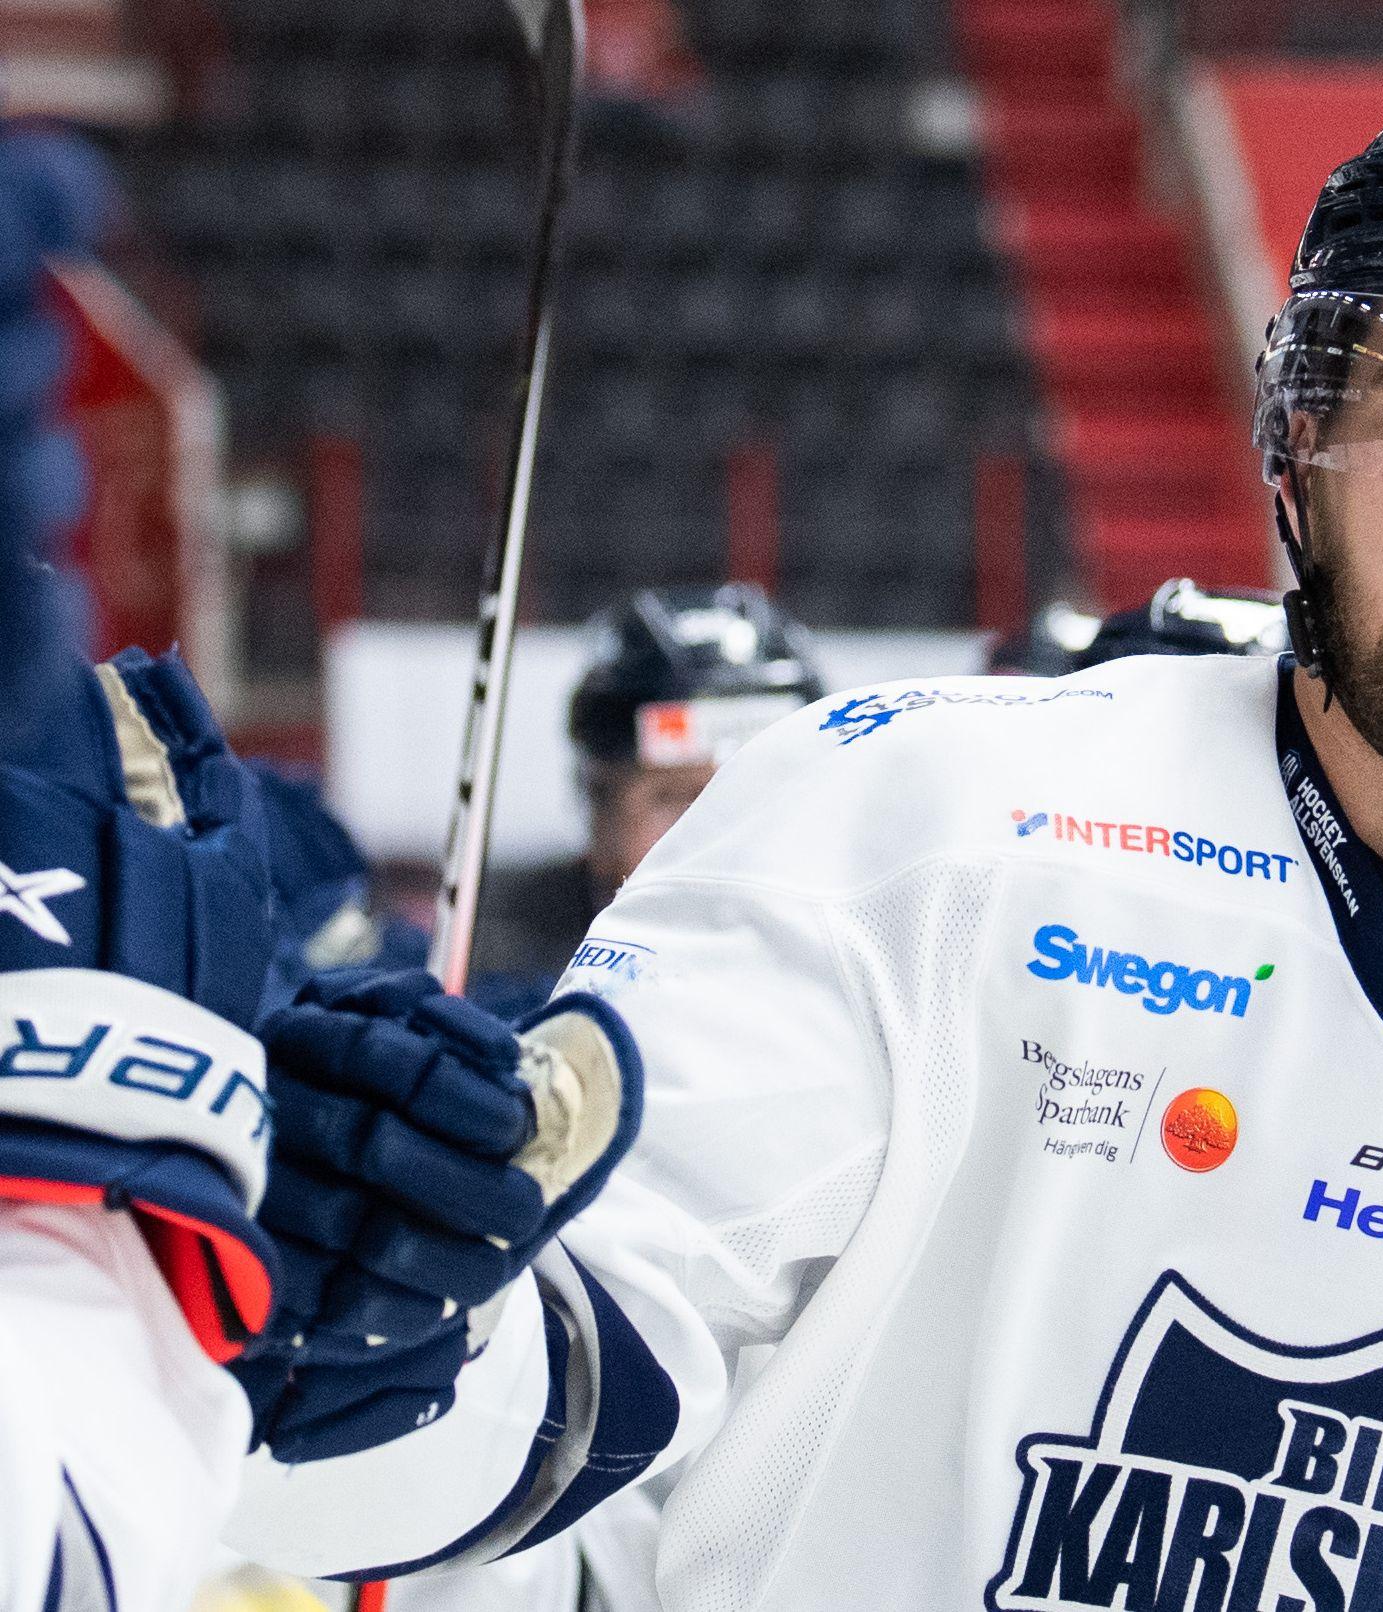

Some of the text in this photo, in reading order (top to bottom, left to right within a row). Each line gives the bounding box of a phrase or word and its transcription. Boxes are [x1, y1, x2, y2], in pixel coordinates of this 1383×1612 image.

[1297, 776, 1347, 848] HOCKEY
[1053, 813, 1293, 883] INTERSPORT
[1290, 794, 1359, 918] ALLSVENSKAN
[1026, 924, 1251, 1018] Swegon
[1021, 1039, 1144, 1095] Bergslagens
[1035, 1083, 1131, 1128] Sparbank
[1095, 1140, 1118, 1162] dig
